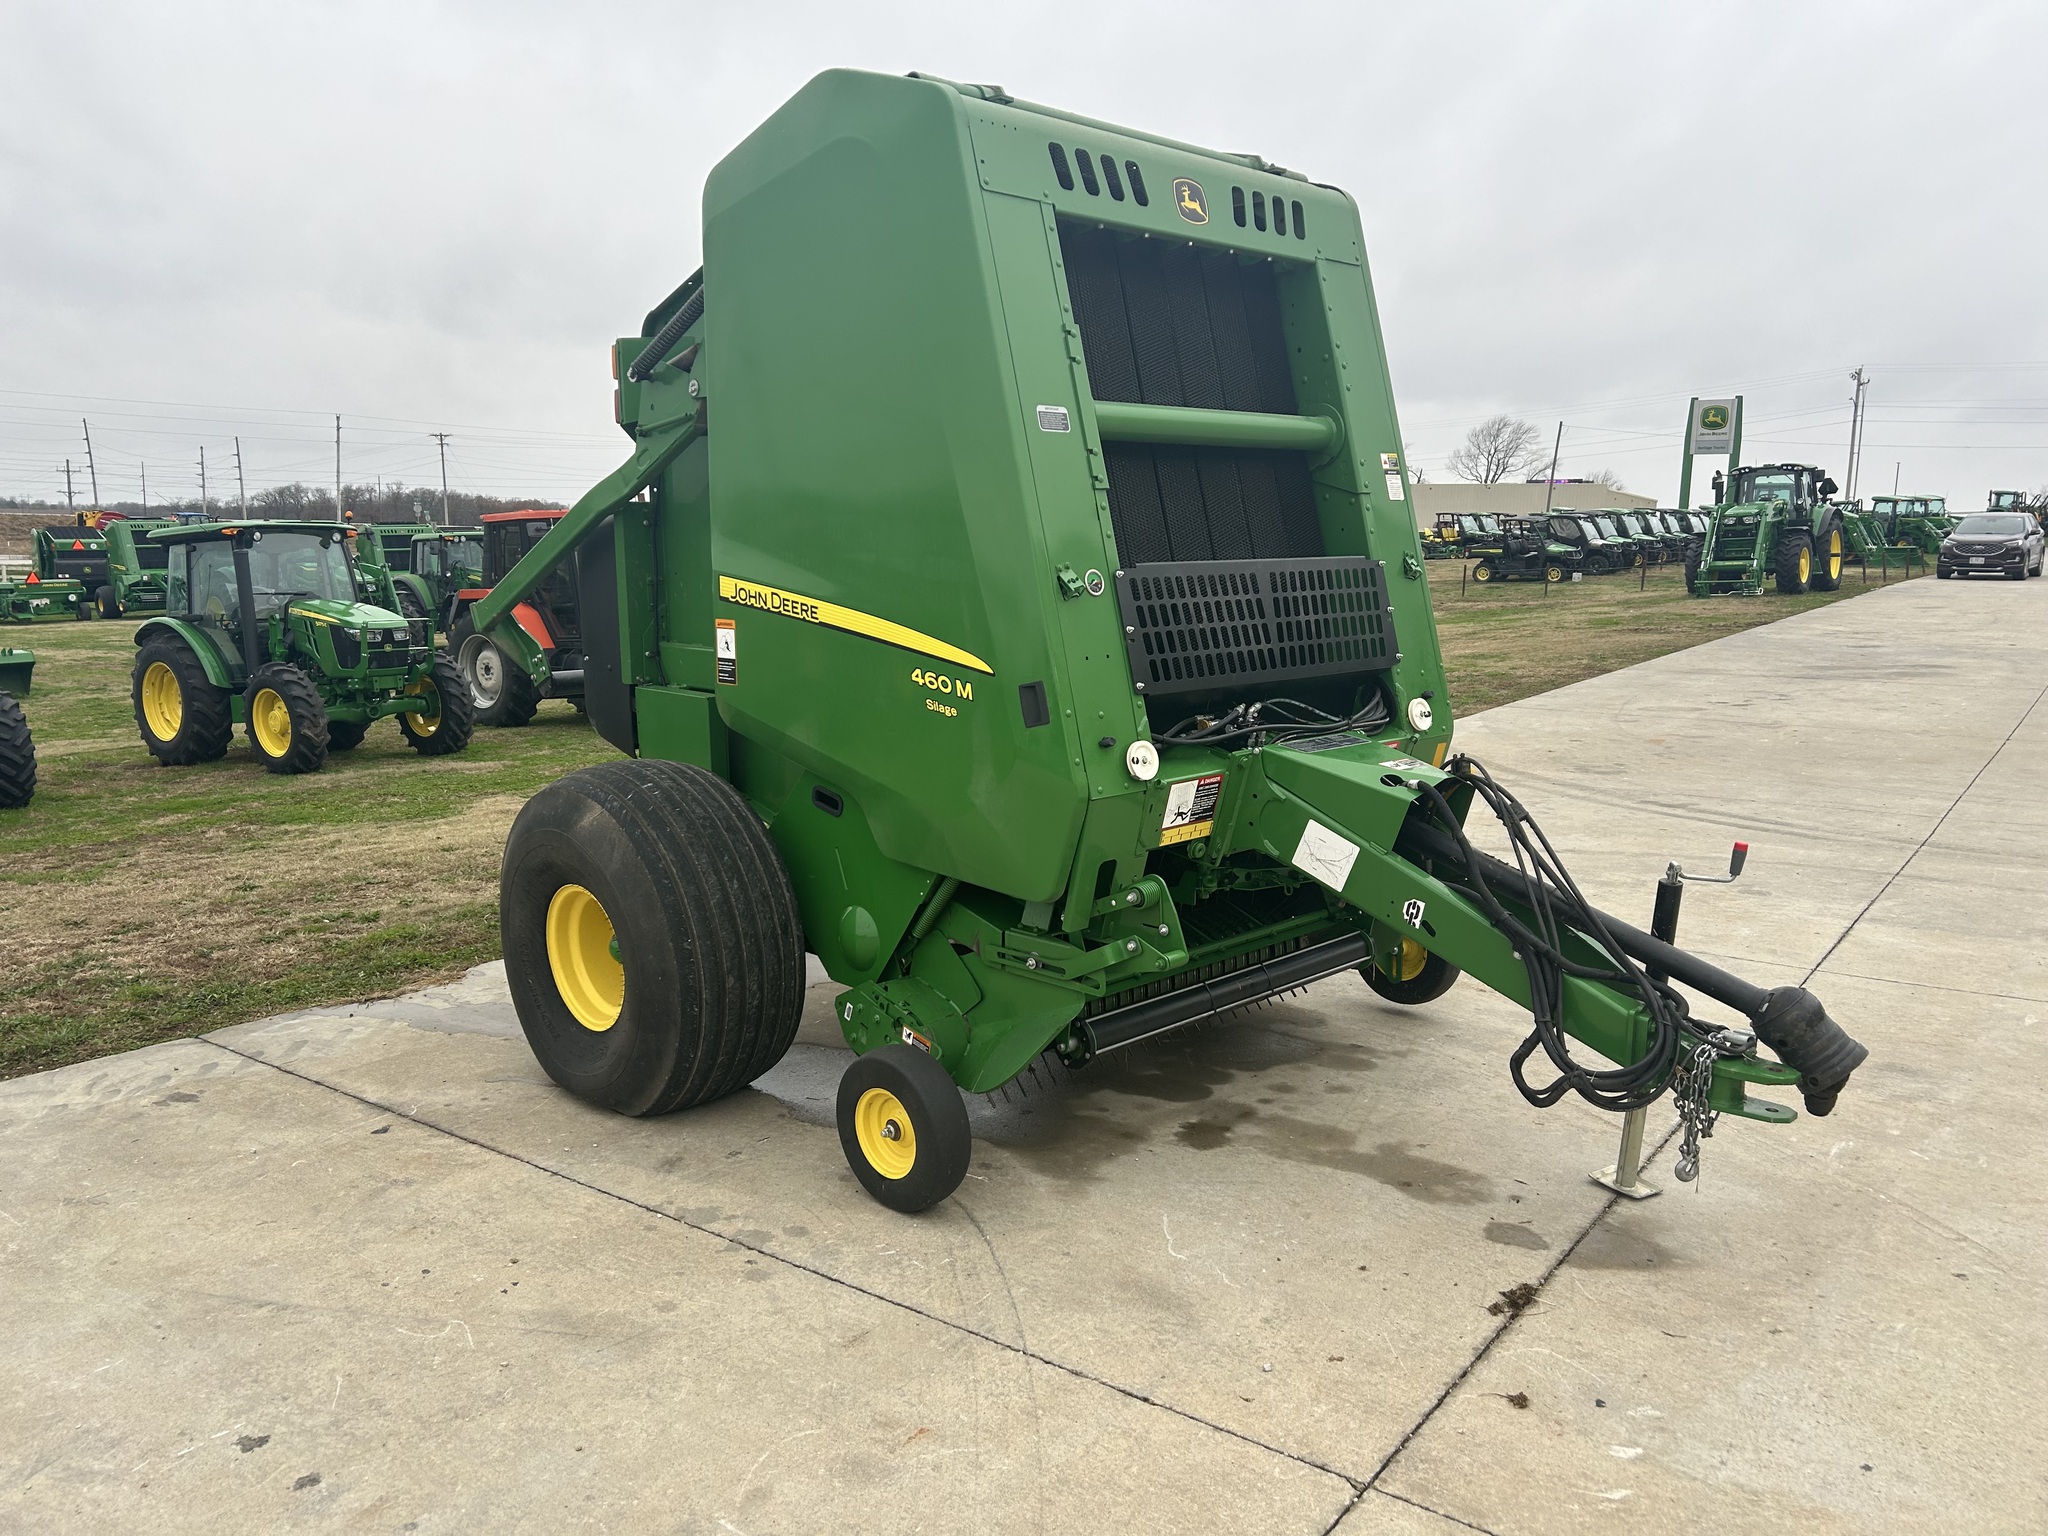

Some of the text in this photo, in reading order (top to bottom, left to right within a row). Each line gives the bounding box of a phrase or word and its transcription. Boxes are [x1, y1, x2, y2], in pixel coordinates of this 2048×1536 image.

[730, 583, 819, 620] JOHN DEERE
[911, 668, 973, 701] 460 M
[925, 698, 958, 717] Silage
